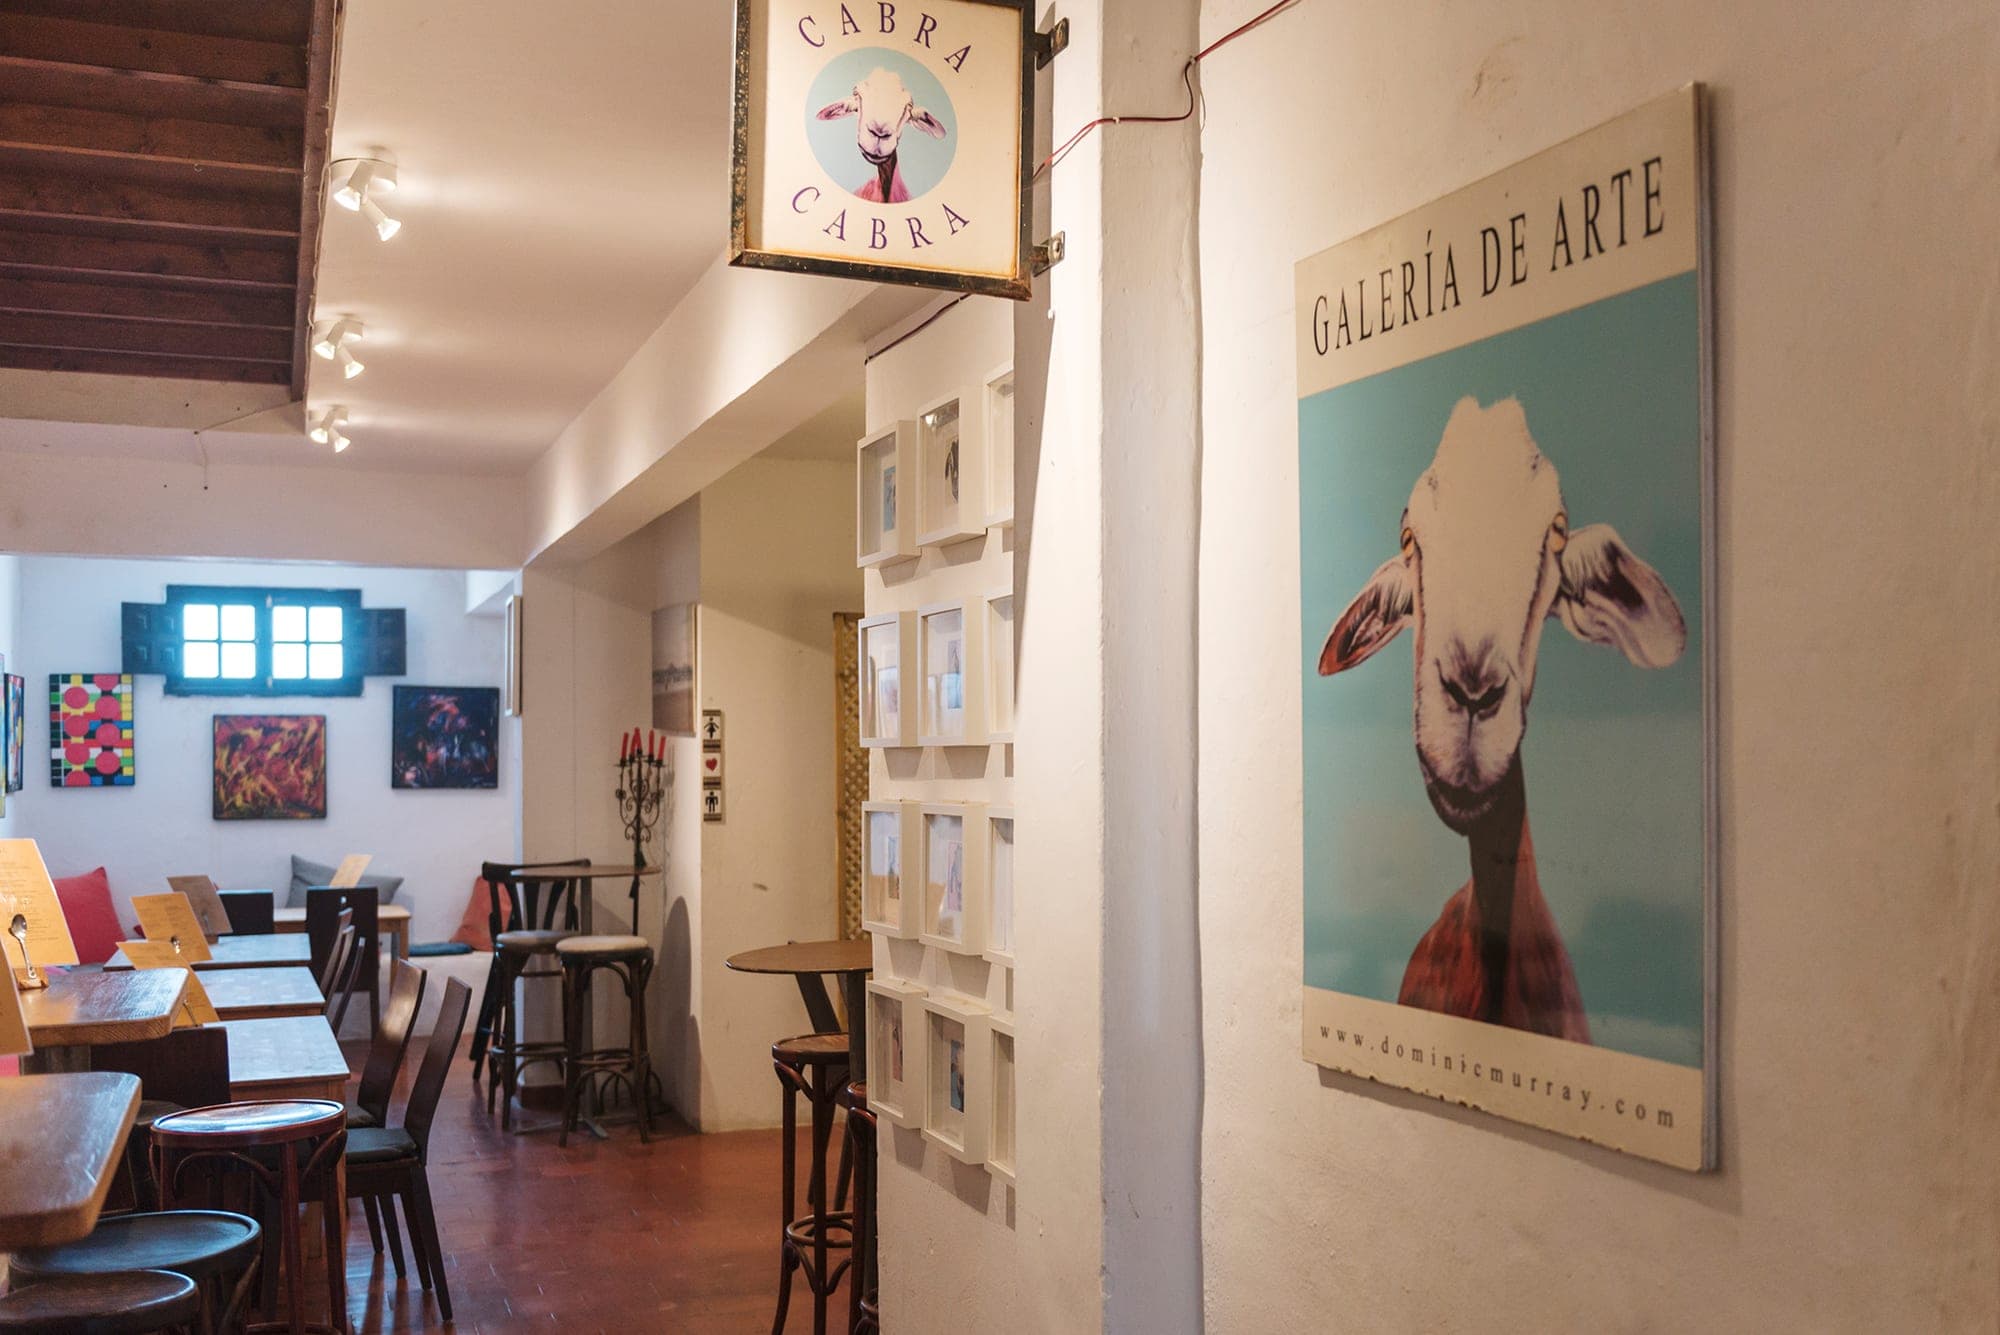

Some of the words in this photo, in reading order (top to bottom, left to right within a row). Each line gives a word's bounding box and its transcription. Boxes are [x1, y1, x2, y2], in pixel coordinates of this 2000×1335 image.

[798, 1, 971, 73] CABRA
[792, 186, 970, 250] CABRA
[1313, 229, 1461, 356] GALERÍA
[1481, 213, 1528, 297] DE
[1550, 156, 1664, 272] ARTE
[1320, 1024, 1675, 1129] www.dominicmurray.com
